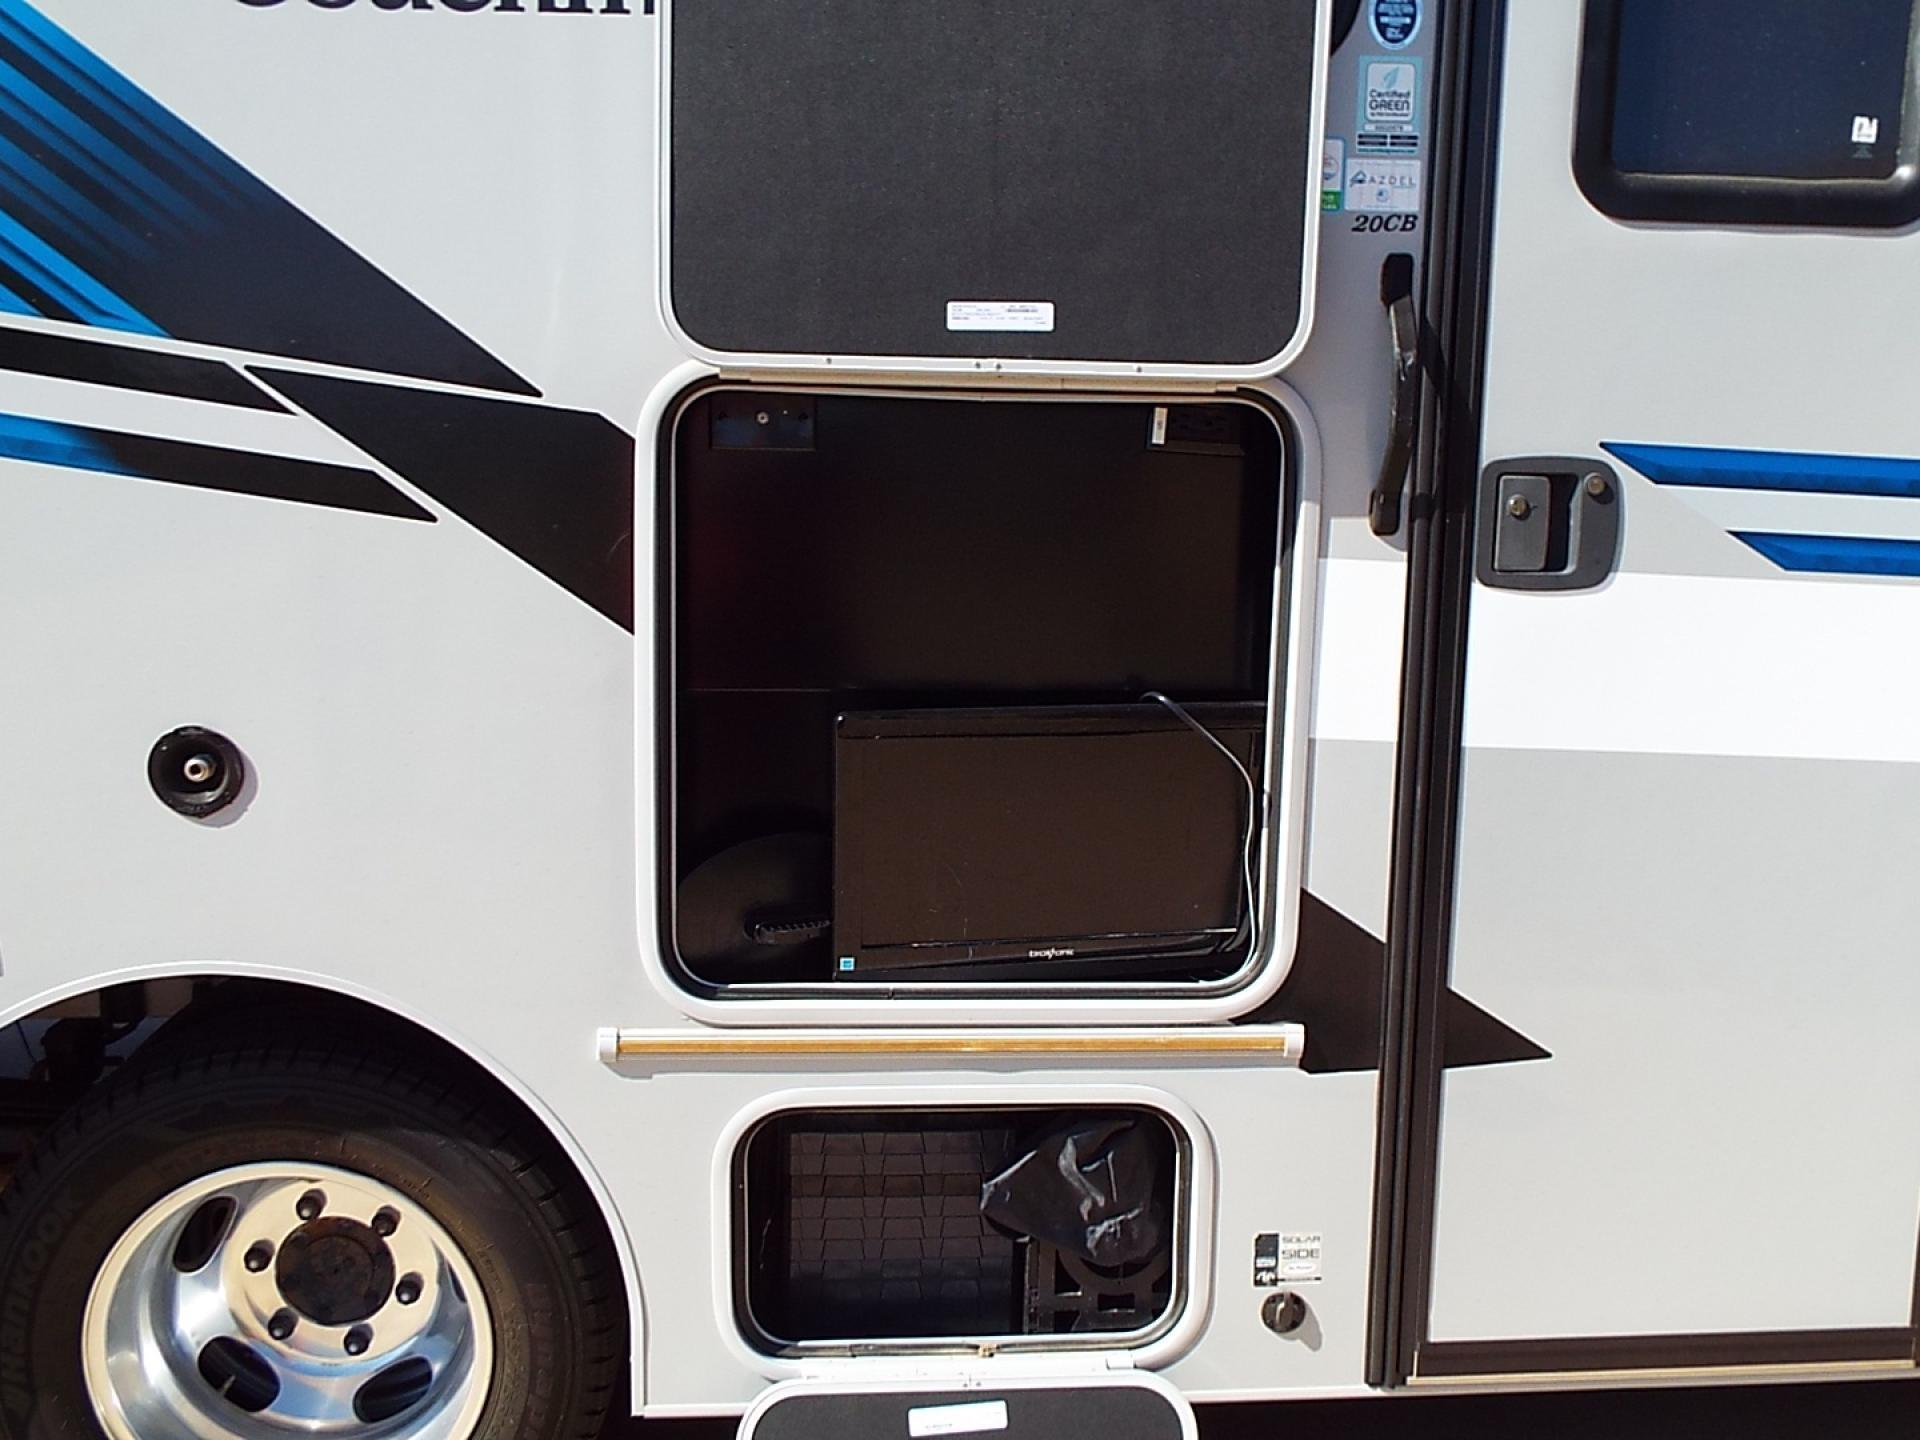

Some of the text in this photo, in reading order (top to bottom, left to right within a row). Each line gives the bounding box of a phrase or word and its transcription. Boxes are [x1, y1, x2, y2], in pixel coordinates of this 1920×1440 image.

[1369, 88, 1410, 98] Certified
[1369, 99, 1410, 111] GREEN
[1368, 175, 1416, 185] AZDEL
[1351, 214, 1418, 233] 20CB
[1282, 1235, 1321, 1244] SOLAR
[1281, 1248, 1321, 1260] SIDE
